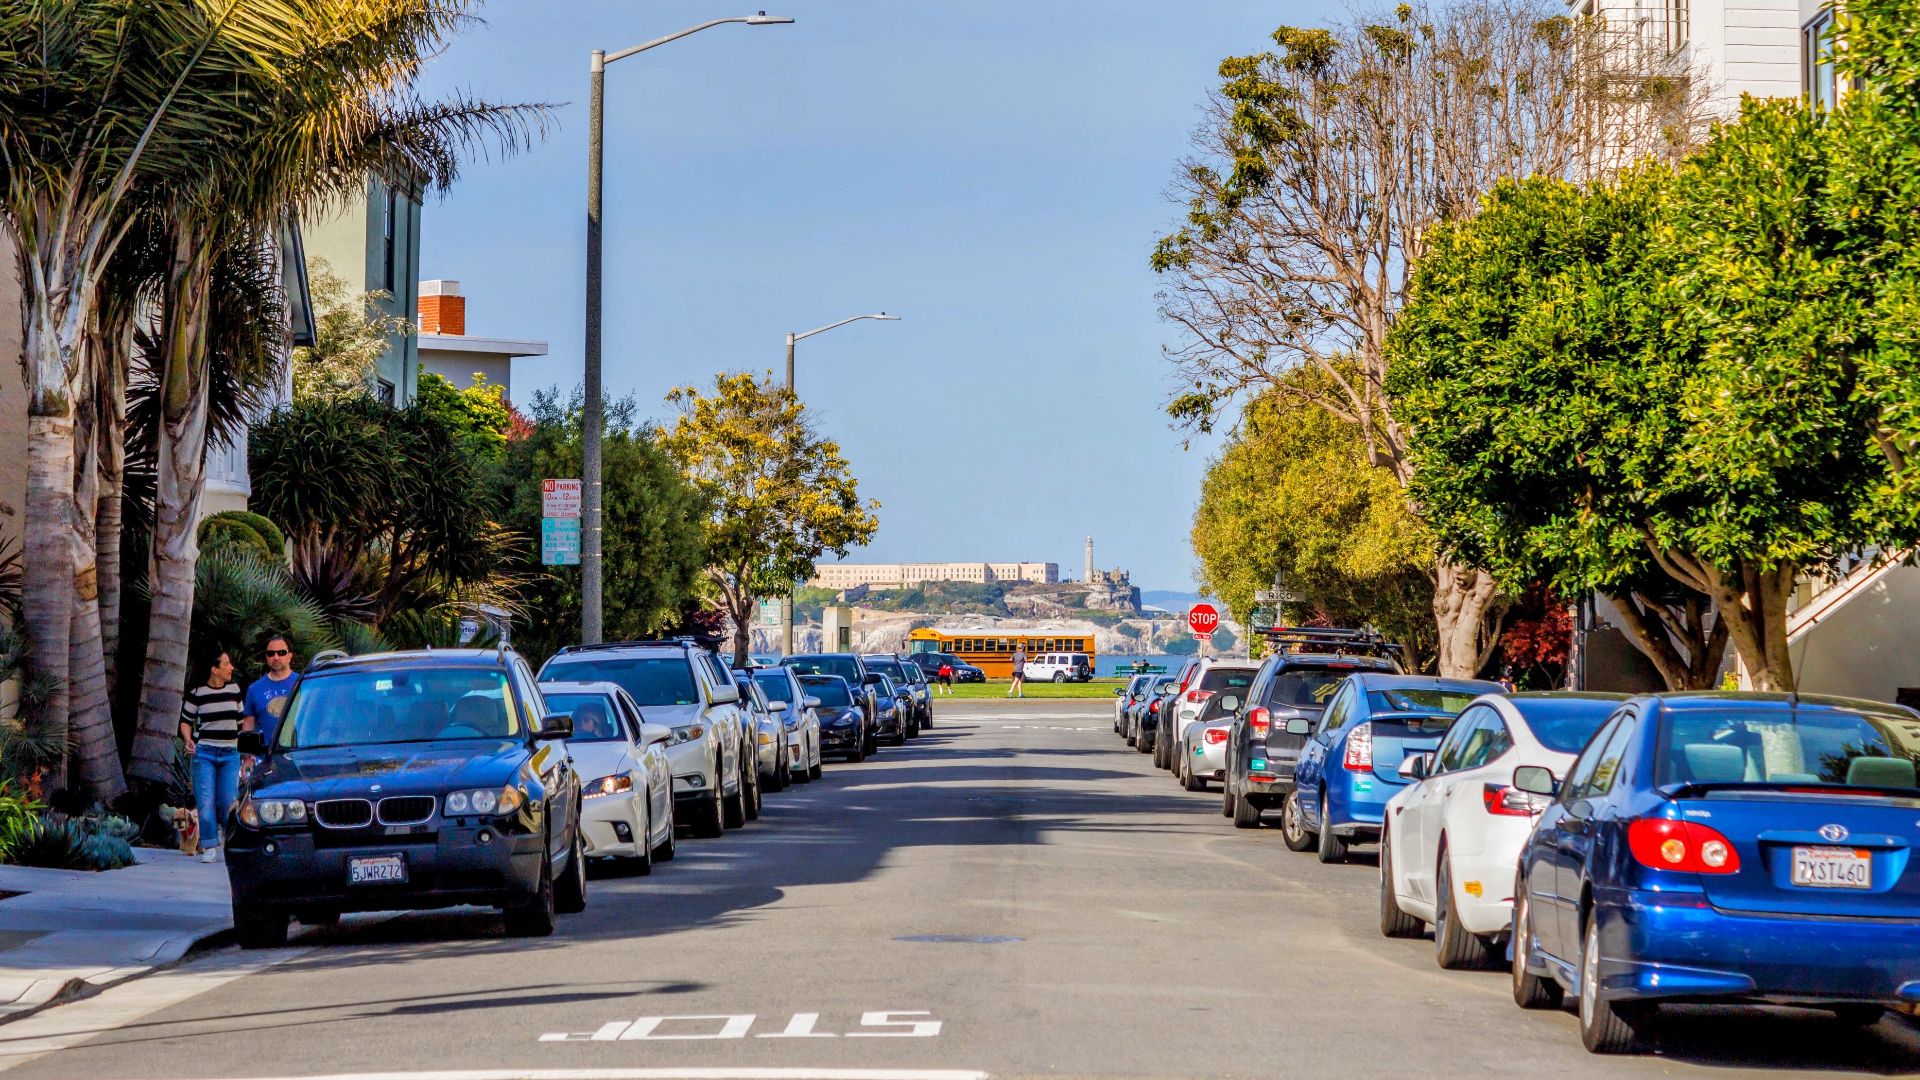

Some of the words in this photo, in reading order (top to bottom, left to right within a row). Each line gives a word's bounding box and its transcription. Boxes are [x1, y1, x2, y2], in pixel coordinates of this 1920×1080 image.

[544, 481, 554, 491] NO
[1191, 612, 1216, 624] STOP
[352, 864, 400, 880] 5JWR272
[1798, 861, 1866, 882] 7XST460
[538, 1010, 942, 1041] STOP
